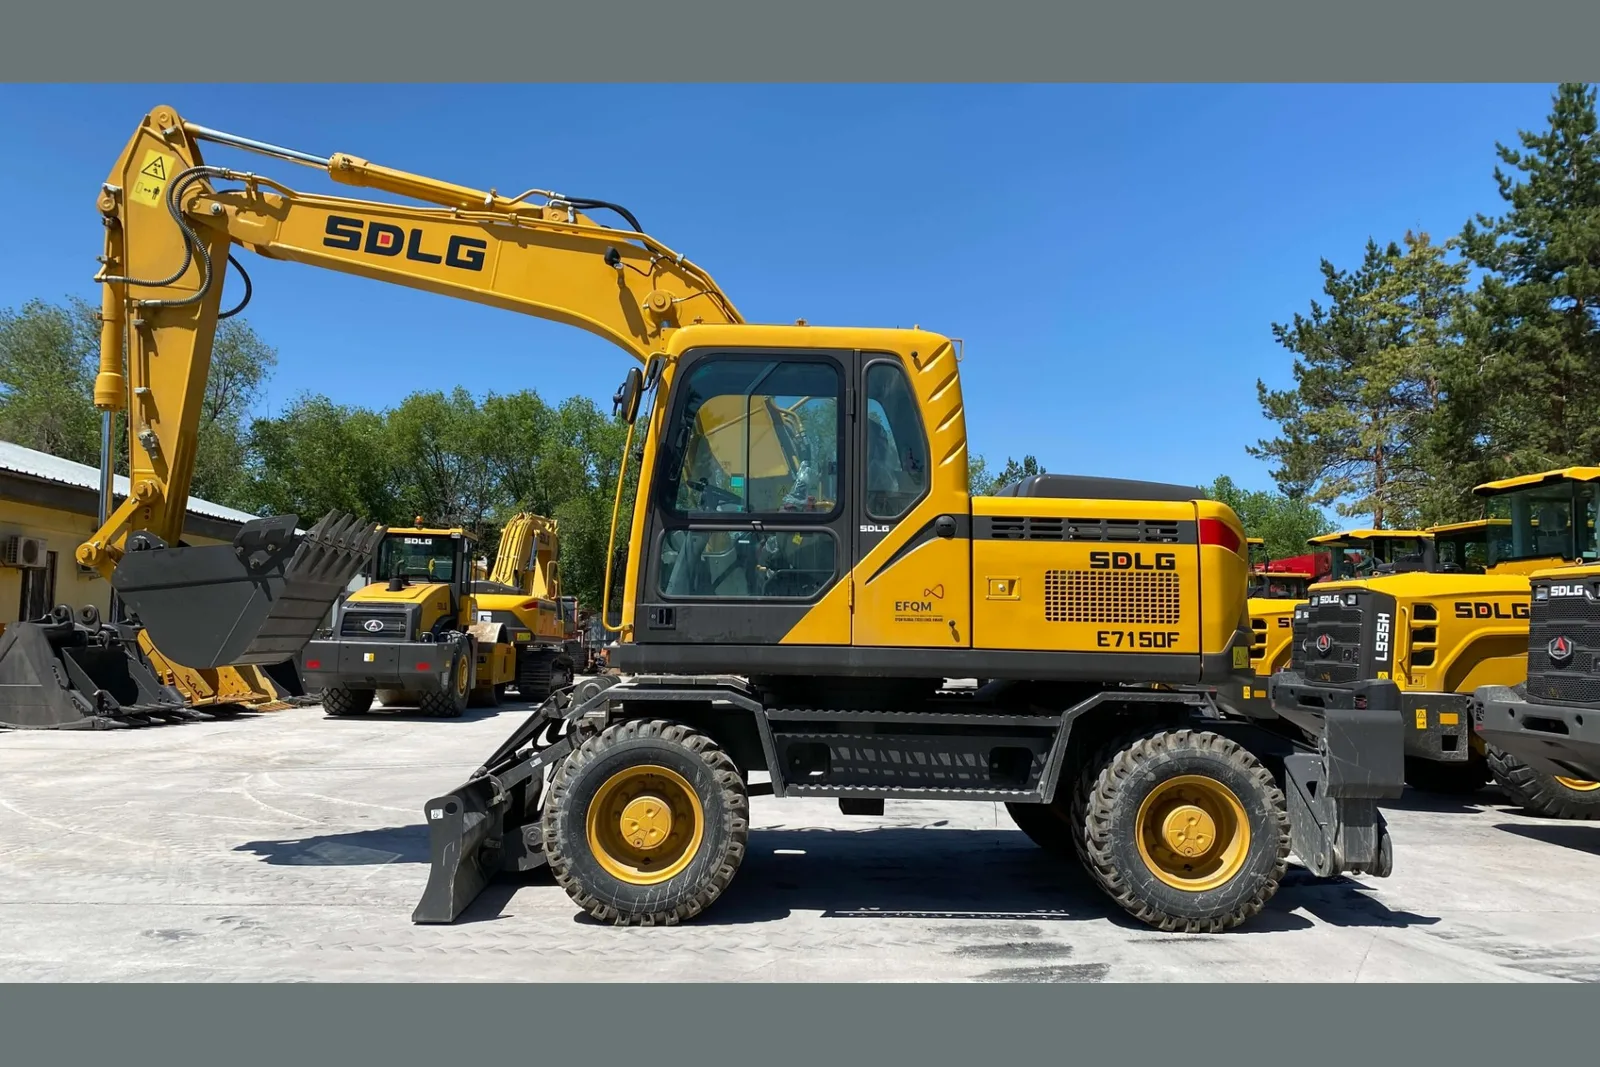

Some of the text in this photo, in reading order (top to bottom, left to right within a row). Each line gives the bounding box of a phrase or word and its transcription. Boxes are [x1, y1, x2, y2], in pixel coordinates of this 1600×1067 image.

[323, 215, 487, 271] SDLG
[1090, 552, 1176, 570] SDLG
[1319, 594, 1340, 604] SDLG
[1550, 585, 1583, 596] SDLG
[895, 601, 932, 612] EFQM
[1454, 602, 1530, 619] SDLG
[1097, 631, 1180, 648] E7150F
[1375, 613, 1390, 661] L935H
